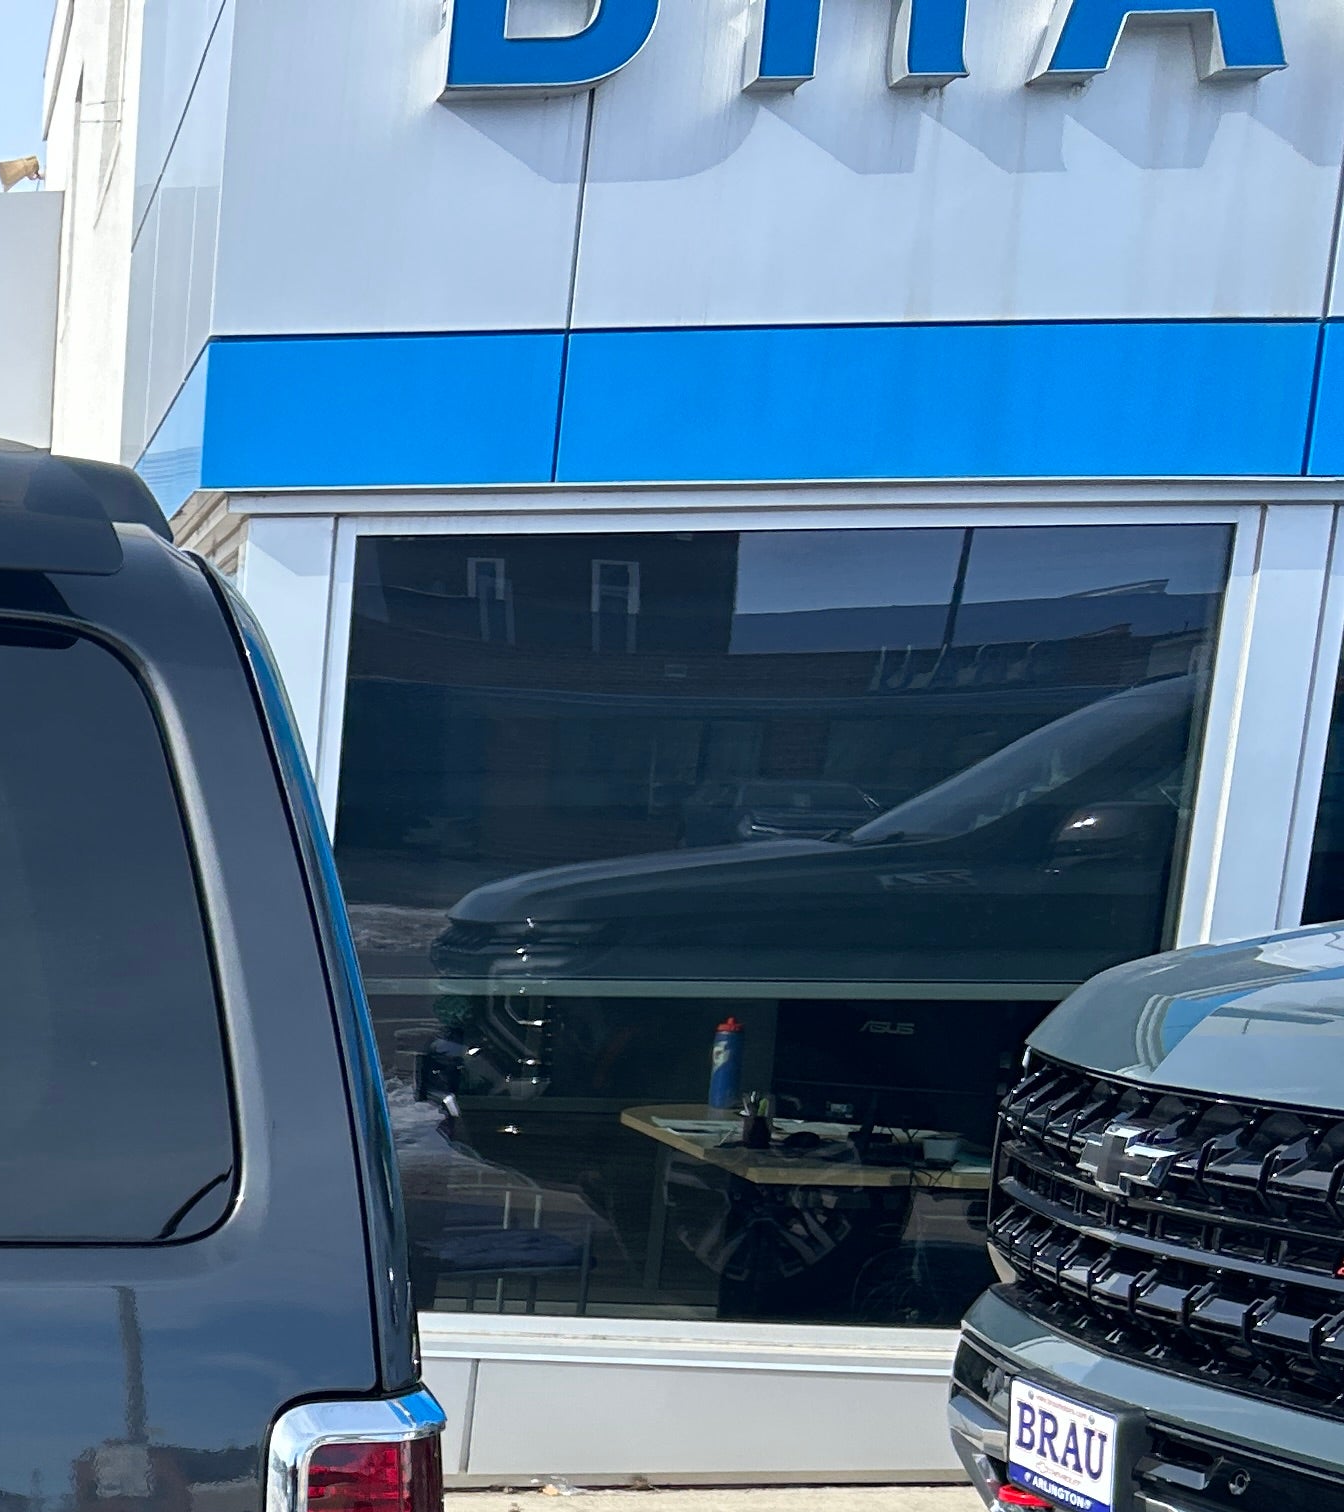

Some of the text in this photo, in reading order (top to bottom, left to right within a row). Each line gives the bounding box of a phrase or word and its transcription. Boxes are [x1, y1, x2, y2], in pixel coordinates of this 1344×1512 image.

[859, 1020, 915, 1034] ASUS
[1016, 1400, 1107, 1480] BRAU
[1032, 1475, 1084, 1510] ARLINGTON
